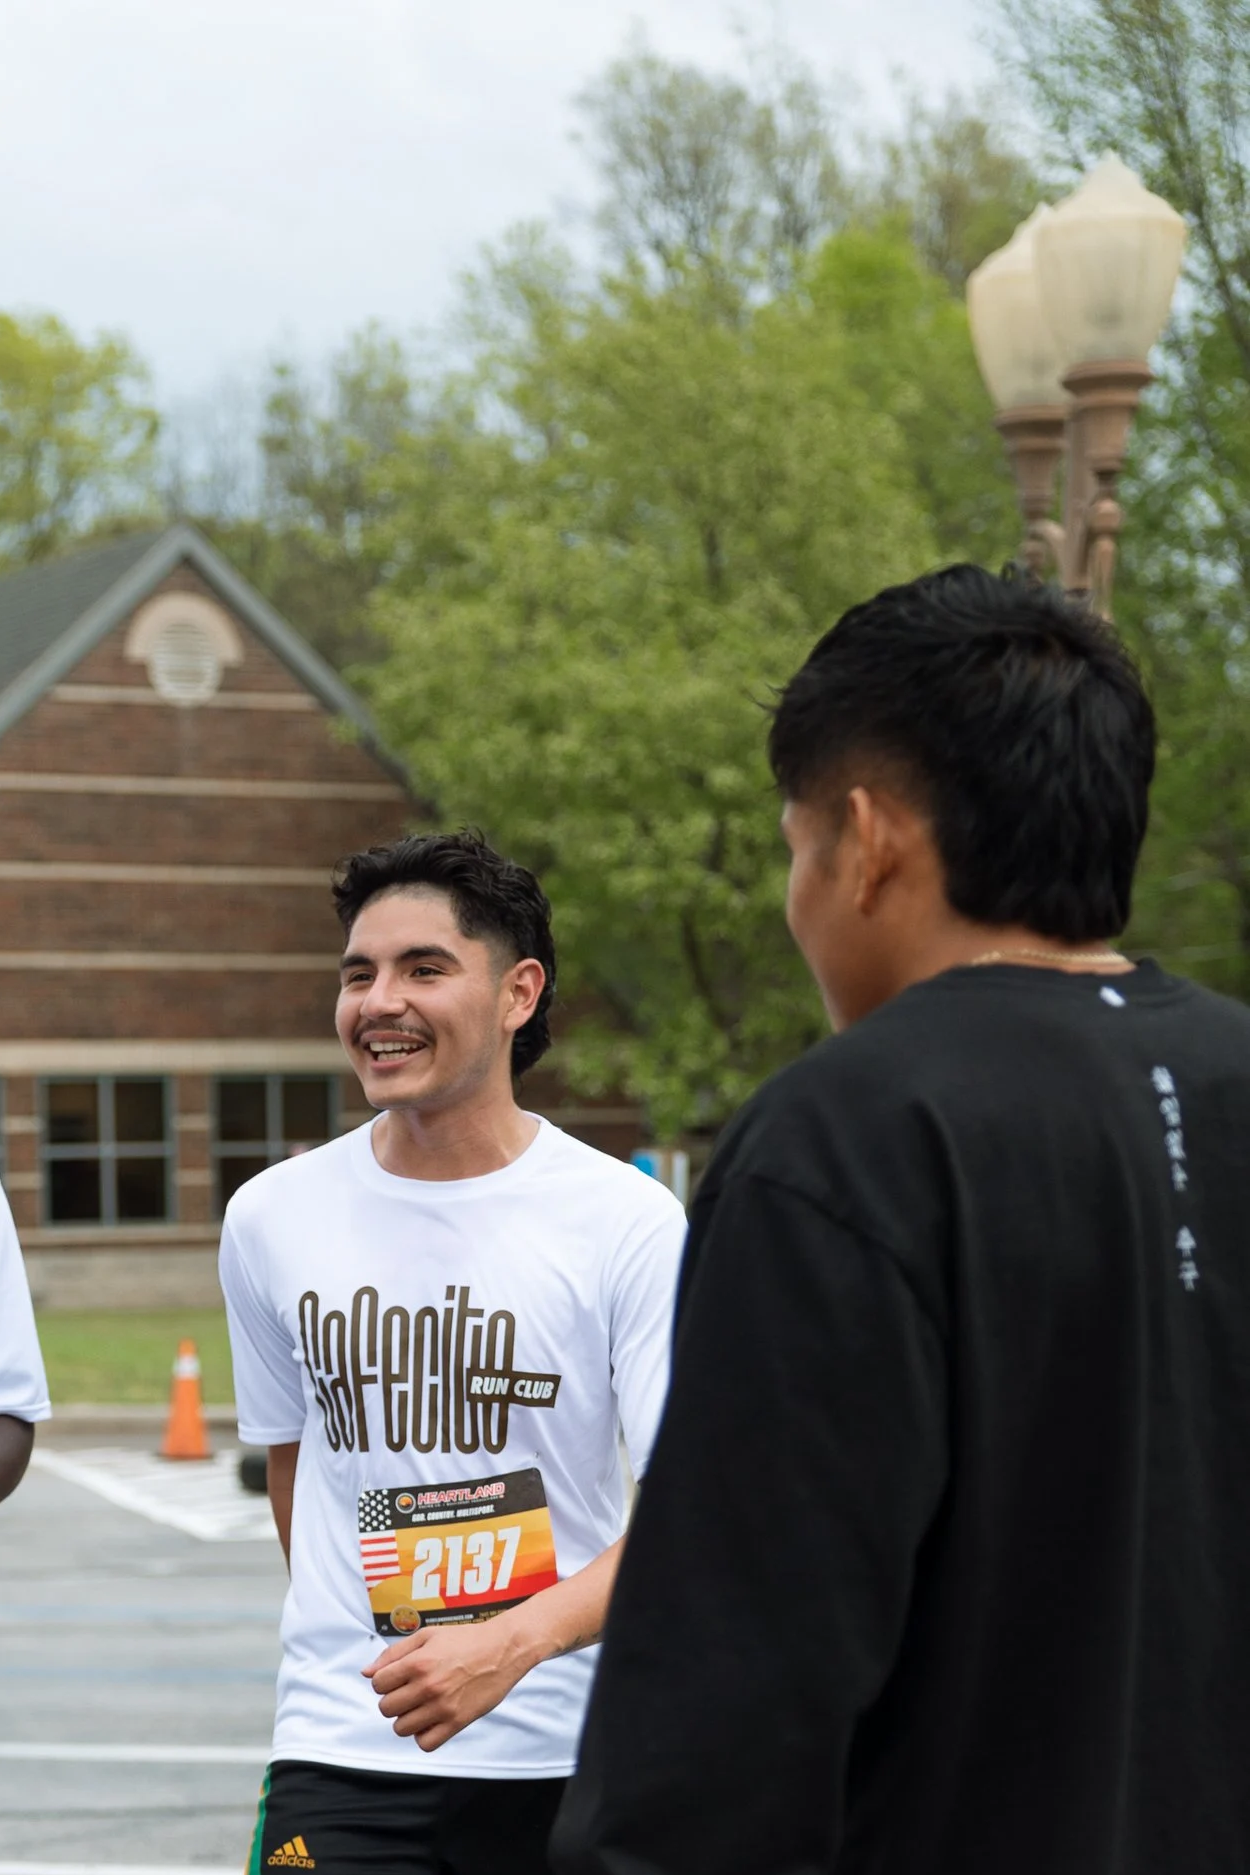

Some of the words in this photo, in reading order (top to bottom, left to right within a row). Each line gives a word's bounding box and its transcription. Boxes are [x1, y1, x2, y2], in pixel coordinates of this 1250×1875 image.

[470, 1376, 510, 1395] RUN
[514, 1379, 555, 1399] CLUB
[418, 1483, 505, 1505] HEARTLAND
[411, 1526, 523, 1601] 2137
[267, 1855, 315, 1868] adidas
